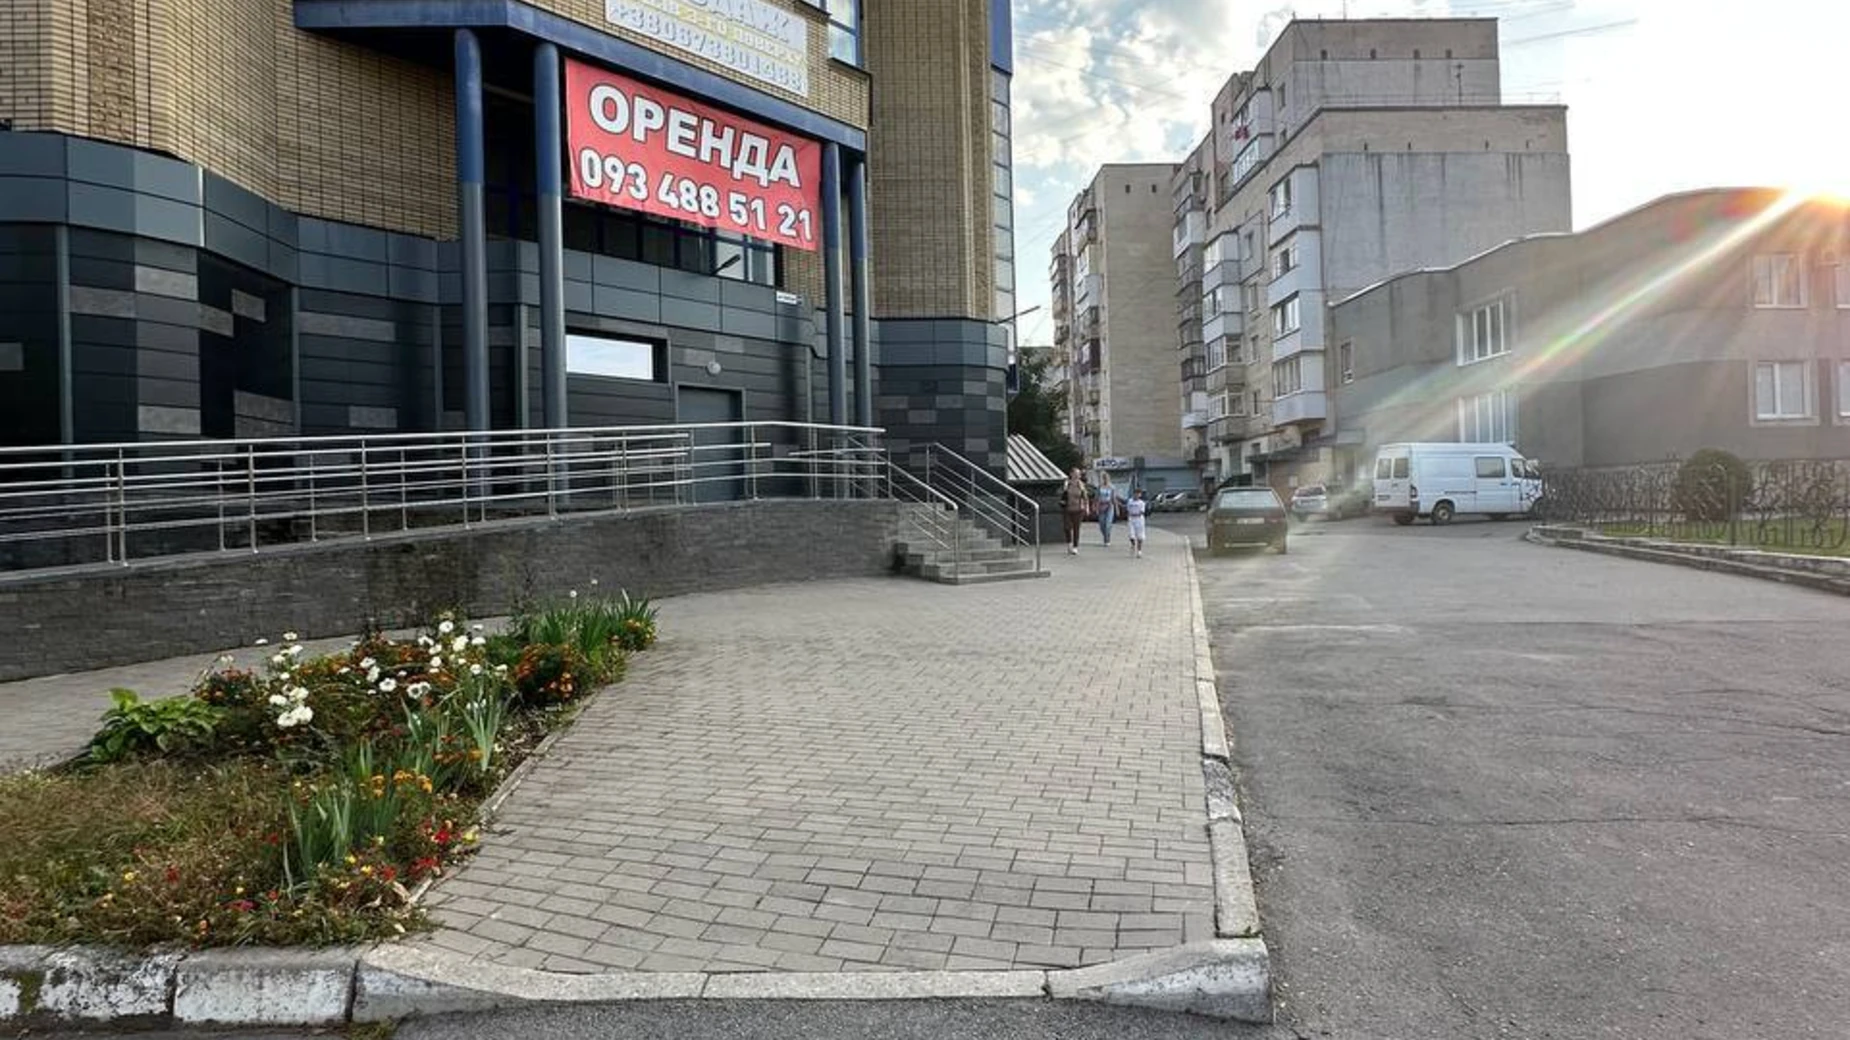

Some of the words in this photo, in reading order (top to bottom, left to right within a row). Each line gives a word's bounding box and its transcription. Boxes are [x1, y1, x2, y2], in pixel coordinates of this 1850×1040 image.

[589, 84, 801, 187] ОРЕНДА
[580, 148, 648, 201] 093
[657, 172, 720, 218] 488
[729, 192, 766, 230] 51
[777, 205, 812, 241] 21
